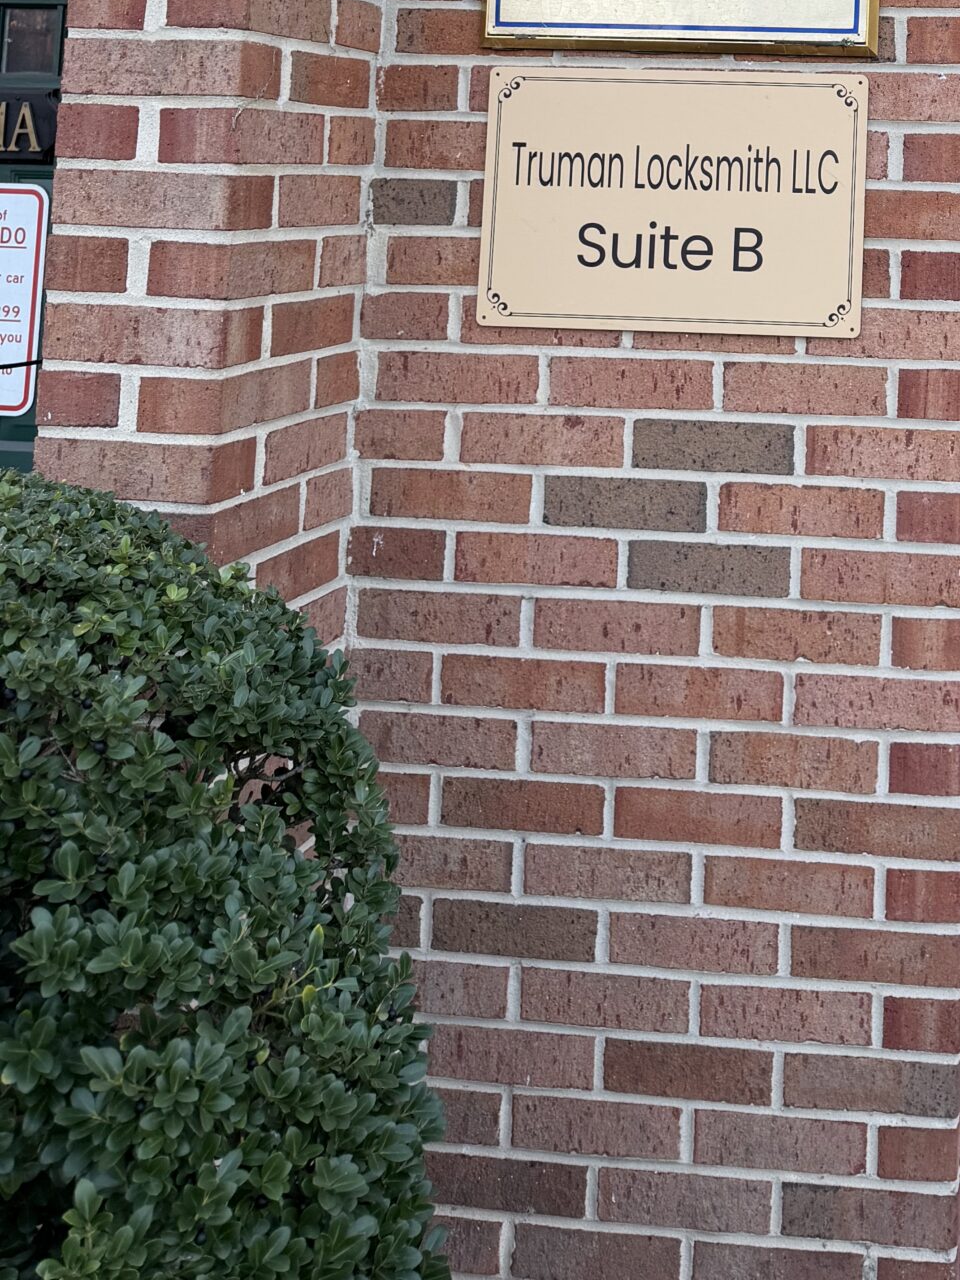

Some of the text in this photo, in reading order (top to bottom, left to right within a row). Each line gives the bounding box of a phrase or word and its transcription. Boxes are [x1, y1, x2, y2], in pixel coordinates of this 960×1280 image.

[511, 141, 840, 195] Truman Locksmith LLC
[576, 221, 764, 272] Suite B
[6, 274, 24, 284] car
[0, 305, 20, 318] 99
